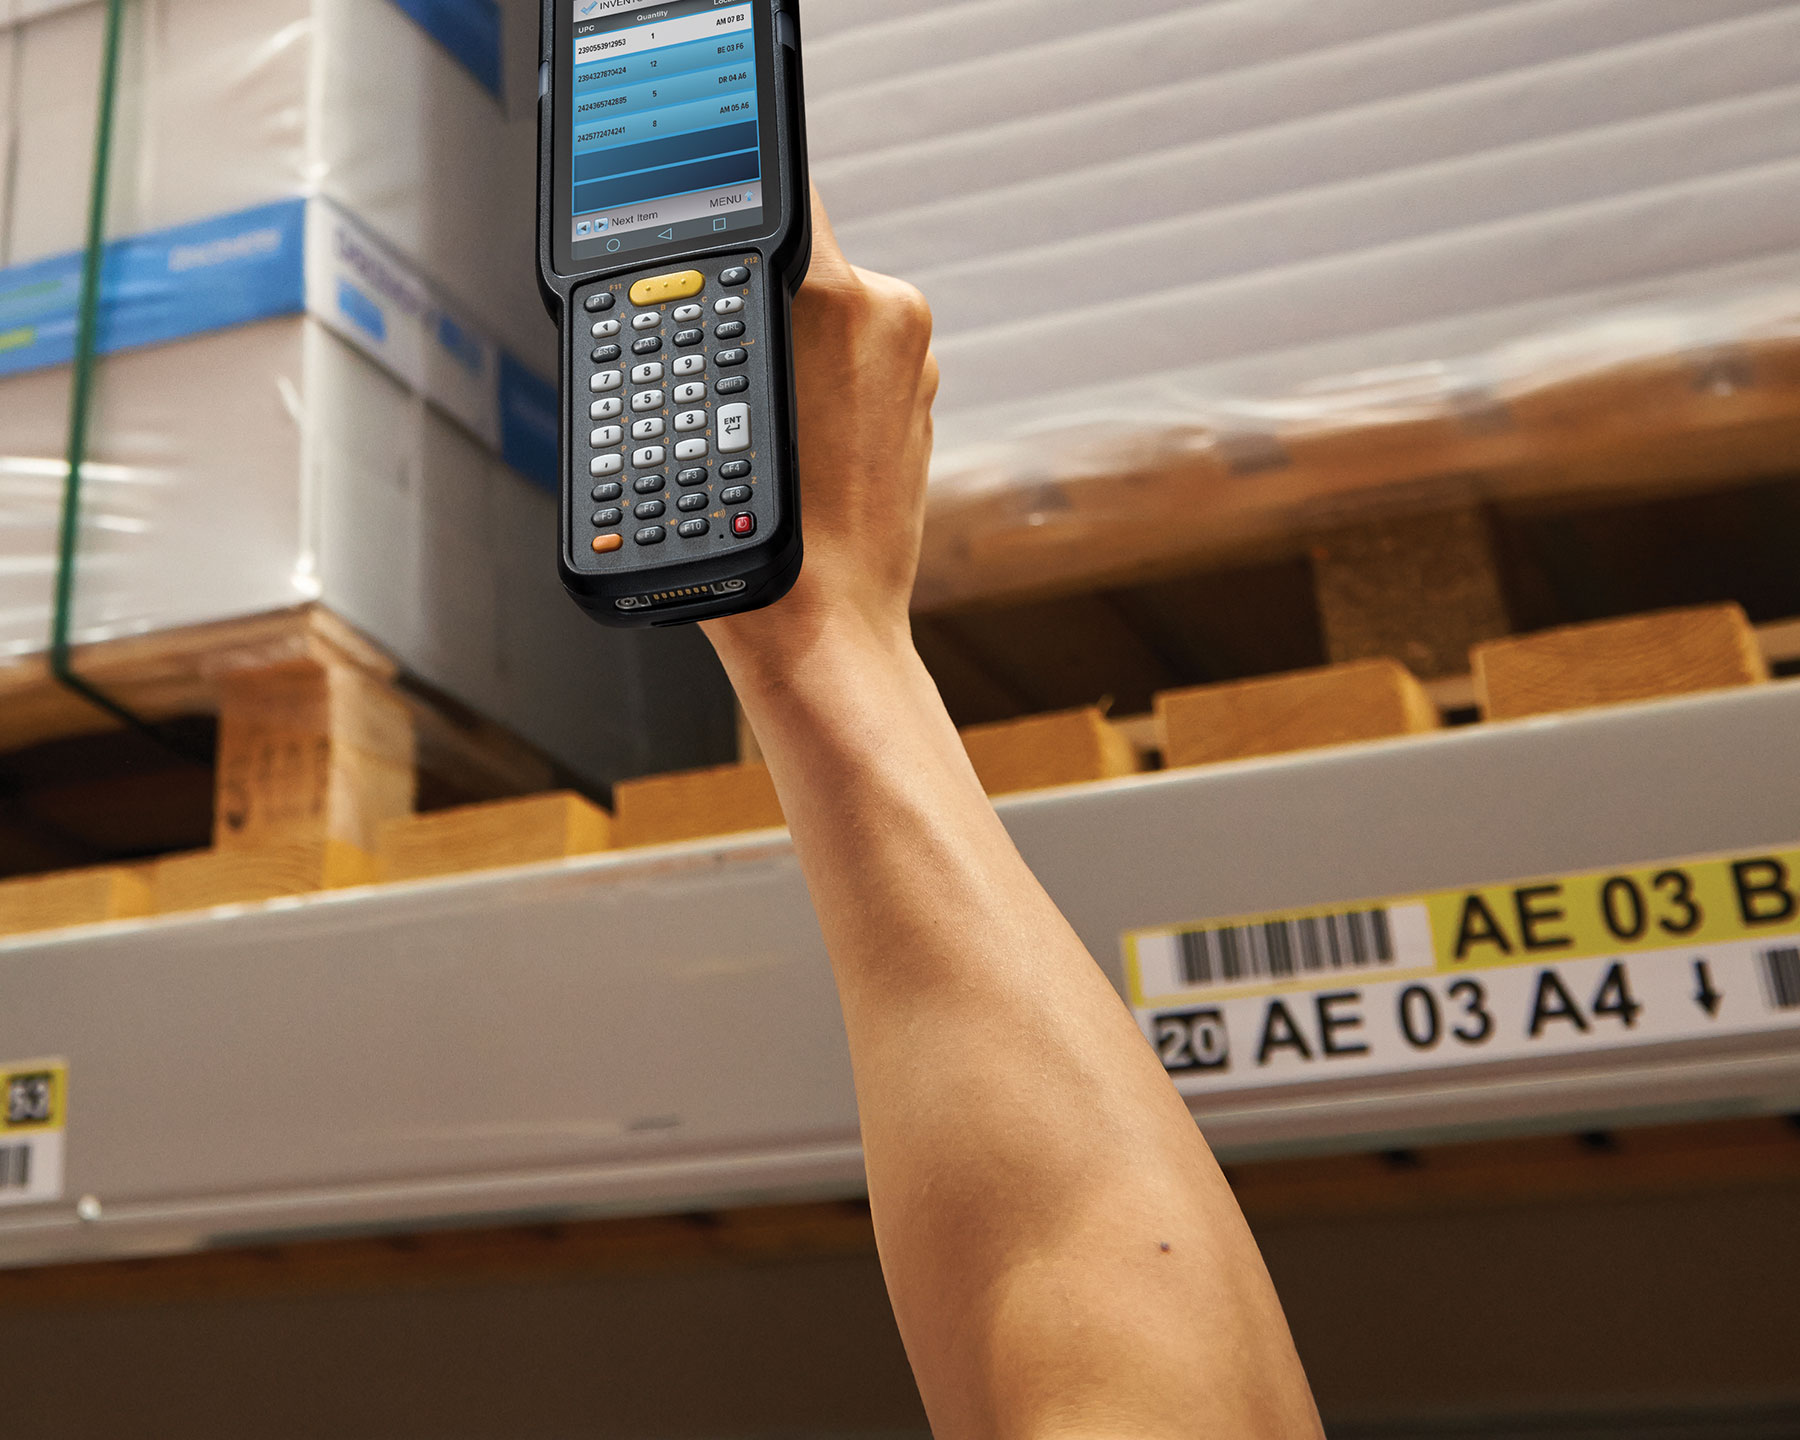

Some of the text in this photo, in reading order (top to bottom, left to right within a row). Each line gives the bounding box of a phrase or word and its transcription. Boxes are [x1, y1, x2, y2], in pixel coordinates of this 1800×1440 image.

[636, 9, 668, 22] Quantity
[716, 17, 729, 26] AM
[729, 14, 738, 23] 07
[578, 24, 595, 33] UPC
[578, 38, 626, 54] 2390553912953
[717, 42, 744, 55] BE 03 F6
[650, 60, 657, 68] 12
[578, 67, 627, 82] 2394327870424
[718, 72, 747, 84] DR 04 A6
[652, 90, 657, 98] 5
[719, 101, 750, 114] AM 05 A6
[652, 120, 657, 128] 8
[577, 127, 626, 142] 2425772474241
[709, 193, 742, 208] MENU
[612, 210, 658, 227] Next Item
[744, 257, 758, 265] F12
[609, 283, 622, 291] F11
[593, 297, 606, 305] P1
[719, 323, 740, 332] CTRL
[679, 331, 696, 340] ALT
[638, 339, 656, 347] TAB
[597, 347, 615, 355] ESC
[685, 358, 692, 369] 9
[643, 366, 650, 376] 8
[603, 374, 610, 384] 7
[719, 379, 743, 390] SHIFT
[685, 386, 693, 396] 6
[644, 393, 651, 404] 5
[603, 401, 610, 412] 4
[621, 416, 628, 424] M
[686, 414, 693, 424] 3
[724, 416, 741, 425] ENT
[644, 421, 652, 432] 2
[604, 429, 609, 439] 1
[622, 445, 627, 453] P
[644, 449, 652, 460] 0
[729, 463, 740, 473] F4
[686, 470, 698, 480] F3
[643, 478, 655, 487] F2
[602, 485, 613, 493] F1
[729, 489, 741, 498] F8
[687, 497, 698, 506] F7
[643, 504, 655, 513] F6
[601, 511, 613, 520] F5
[684, 522, 701, 531] F10
[645, 529, 656, 538] F9
[1453, 855, 1798, 960] AE 03 B
[1156, 960, 1642, 1069] 20 AE 03 A4
